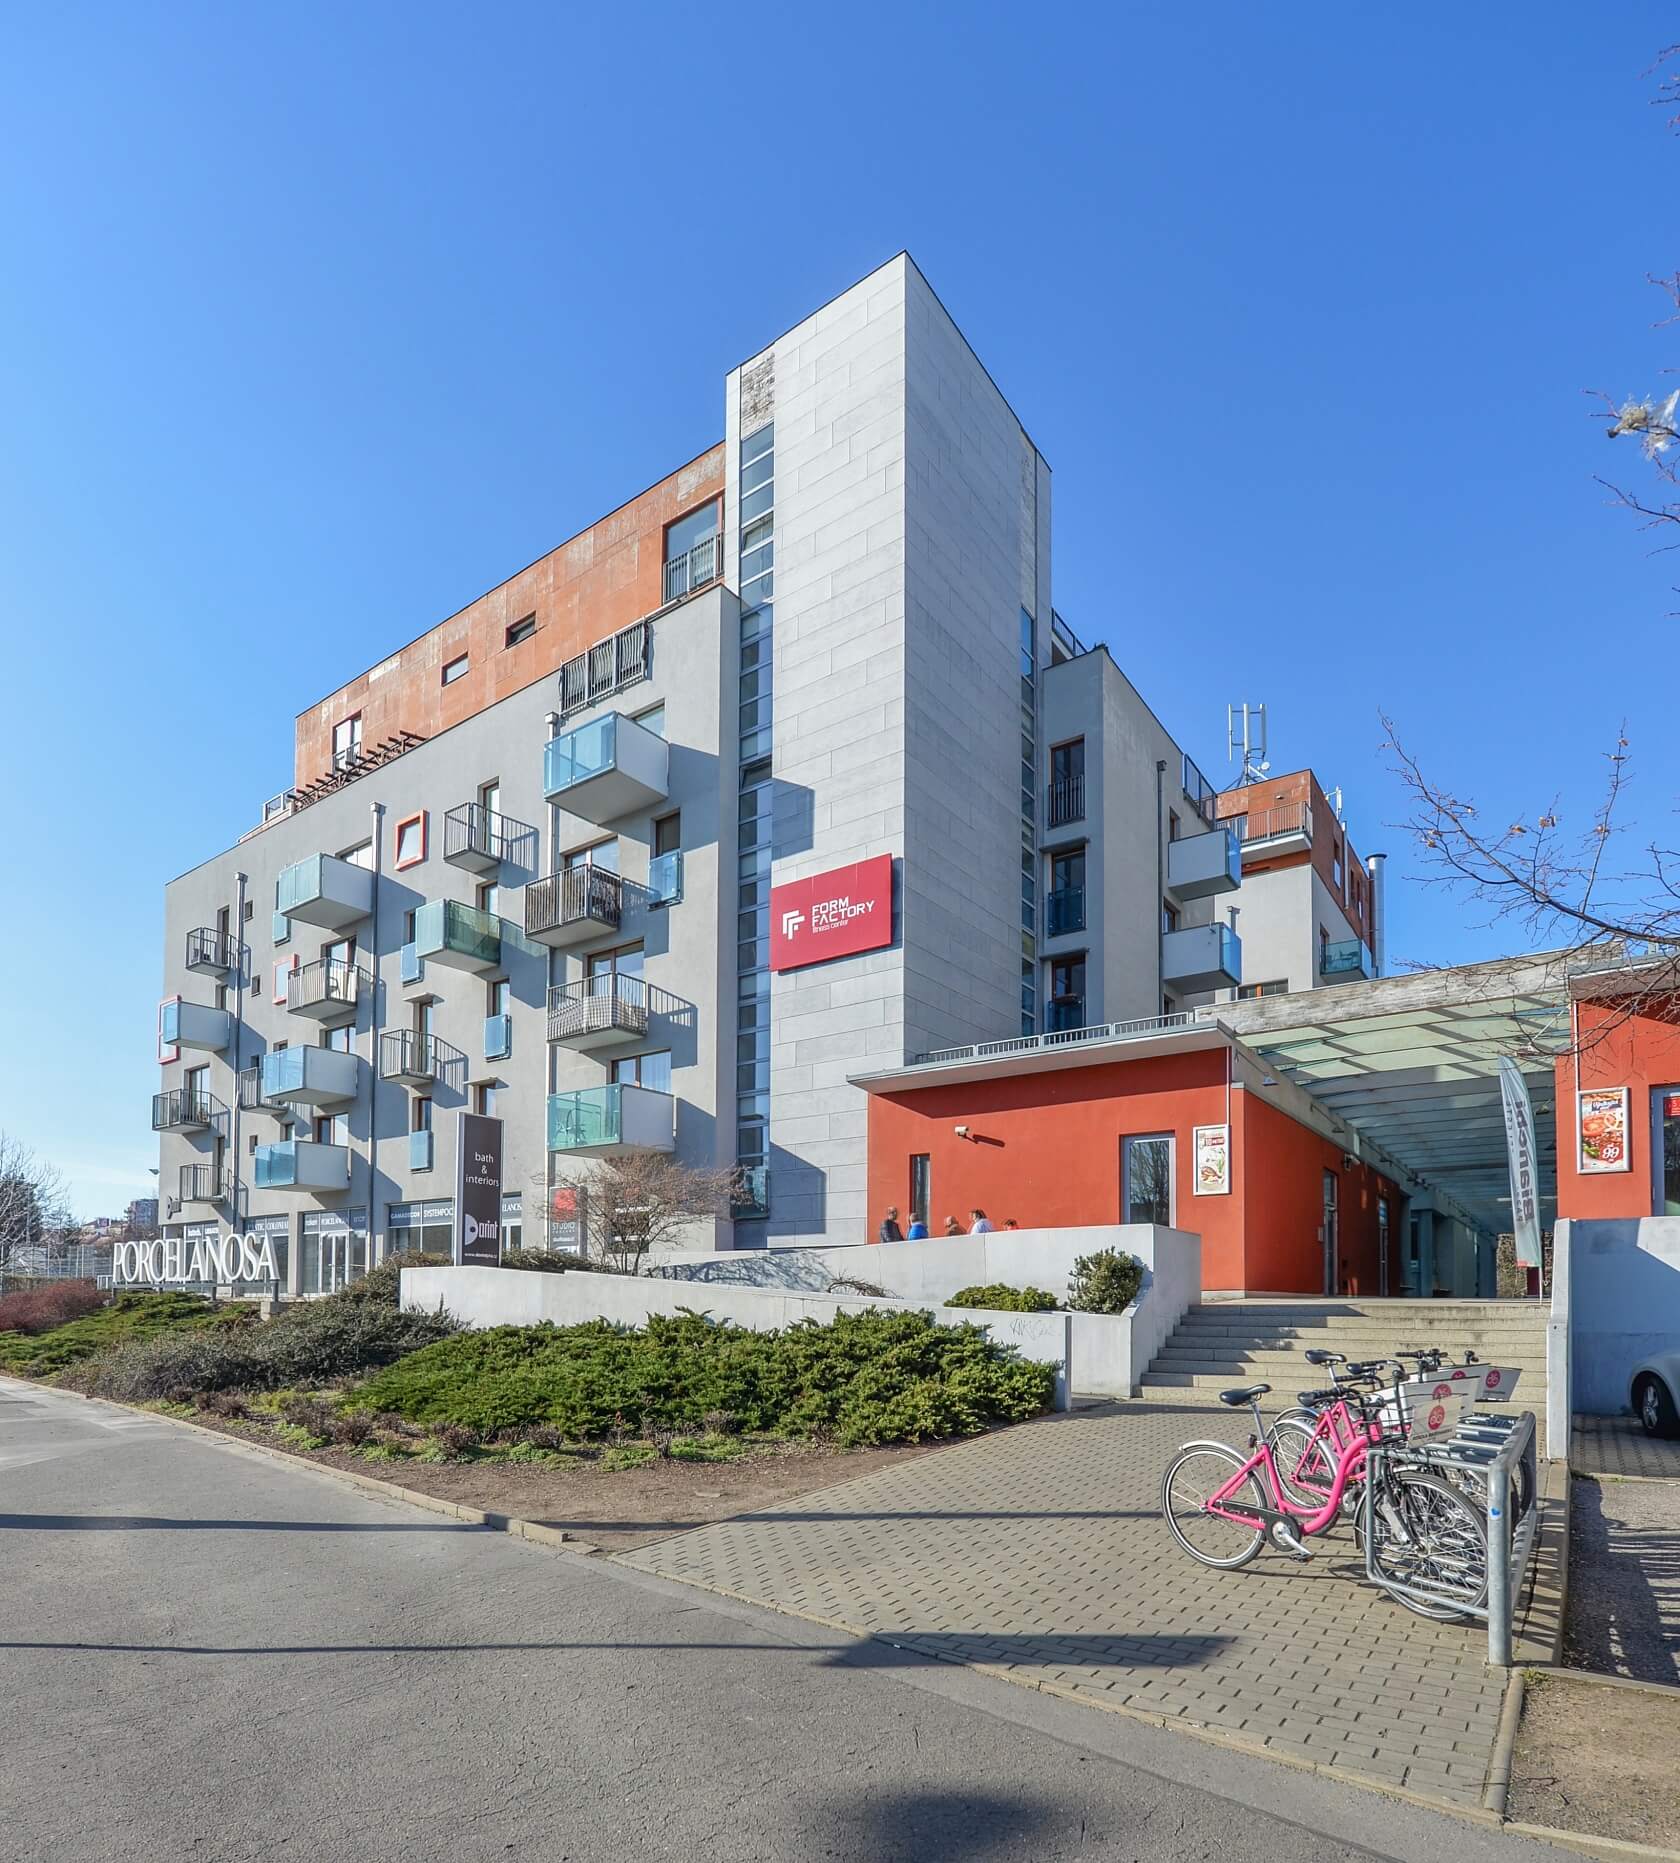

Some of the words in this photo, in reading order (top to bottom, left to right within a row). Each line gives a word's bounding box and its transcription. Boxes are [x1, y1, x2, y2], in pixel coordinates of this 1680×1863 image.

[812, 896, 849, 916] FORM
[812, 900, 875, 927] FACTORY
[475, 1152, 494, 1164] bath
[1602, 1147, 1620, 1159] 99
[481, 1165, 488, 1175] &
[465, 1174, 500, 1188] interiors
[113, 1232, 280, 1284] PORCELANOSA
